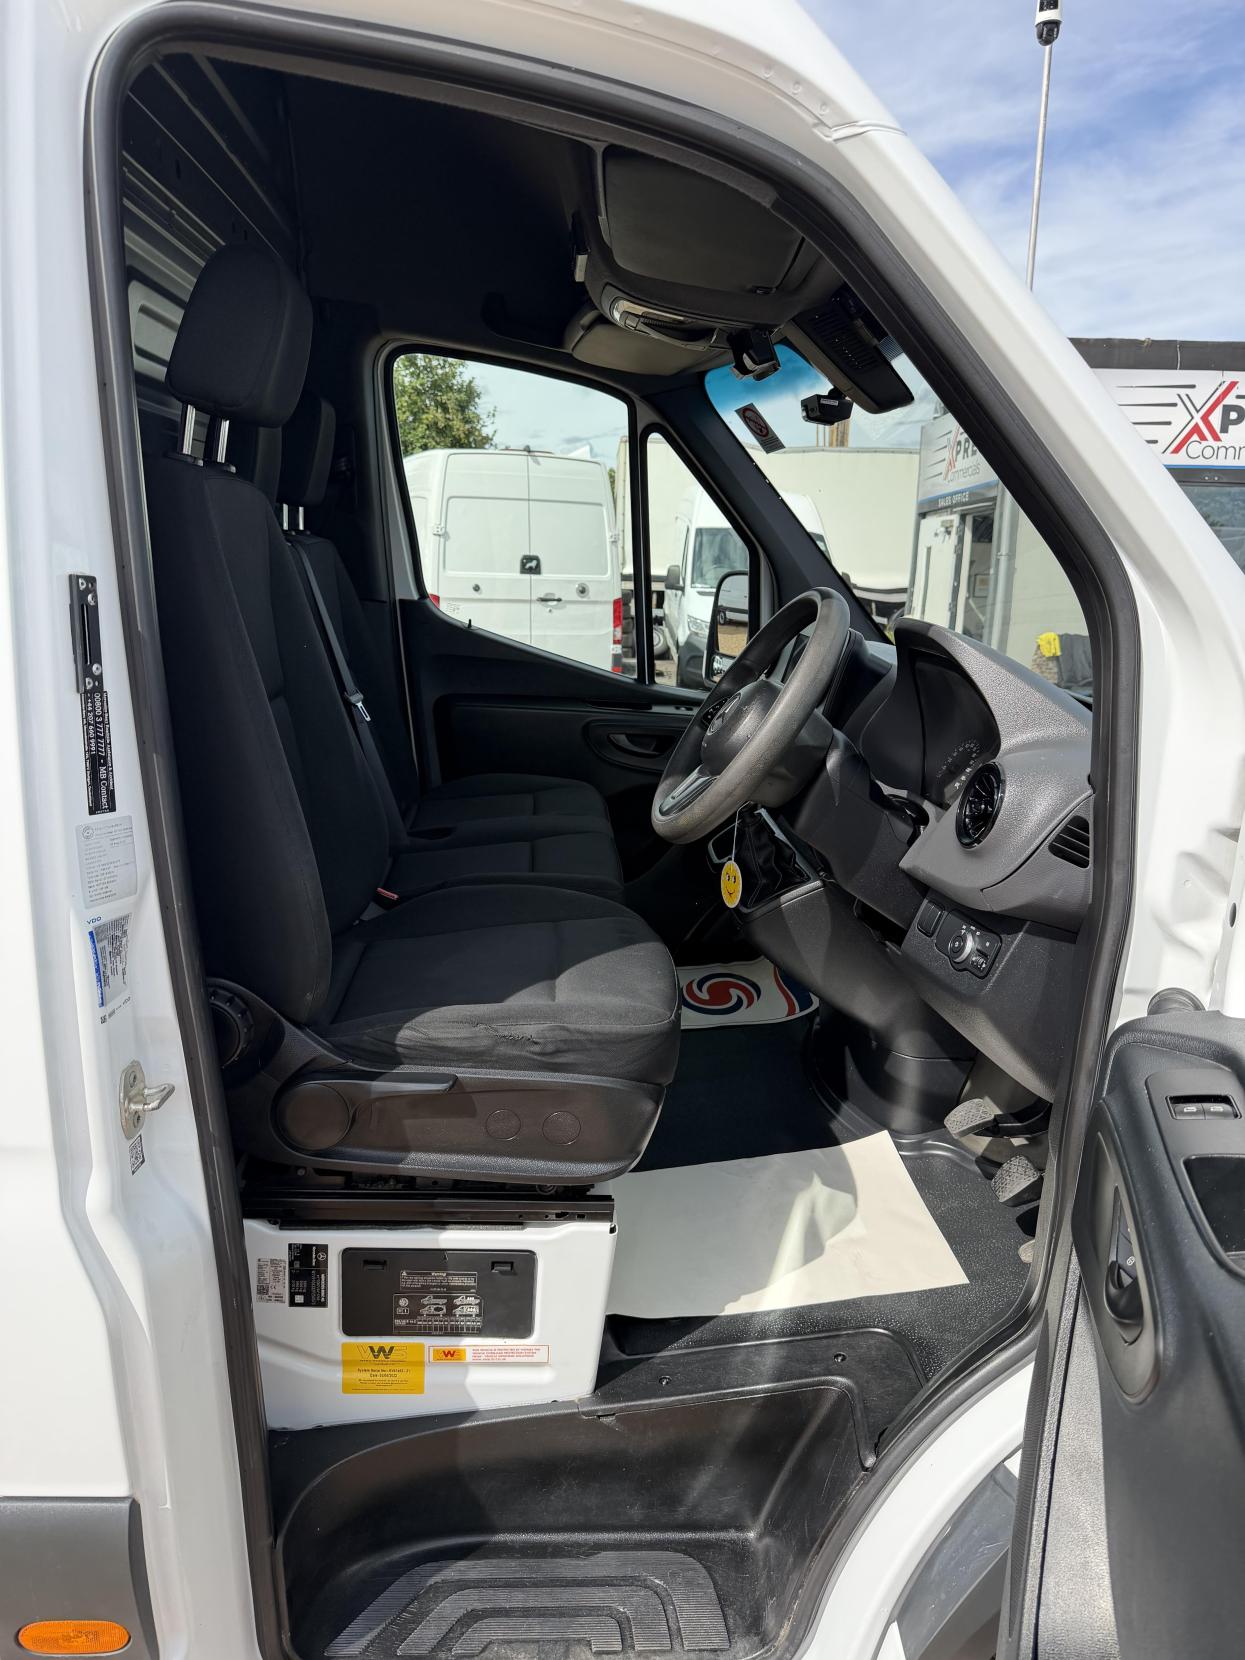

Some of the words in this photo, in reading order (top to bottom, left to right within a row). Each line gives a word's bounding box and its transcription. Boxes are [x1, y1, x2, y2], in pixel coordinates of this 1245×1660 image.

[94, 692, 102, 715] 00800
[96, 723, 104, 737] 777
[97, 738, 105, 756] 7777
[99, 766, 107, 779] MB
[101, 780, 109, 809] Contact
